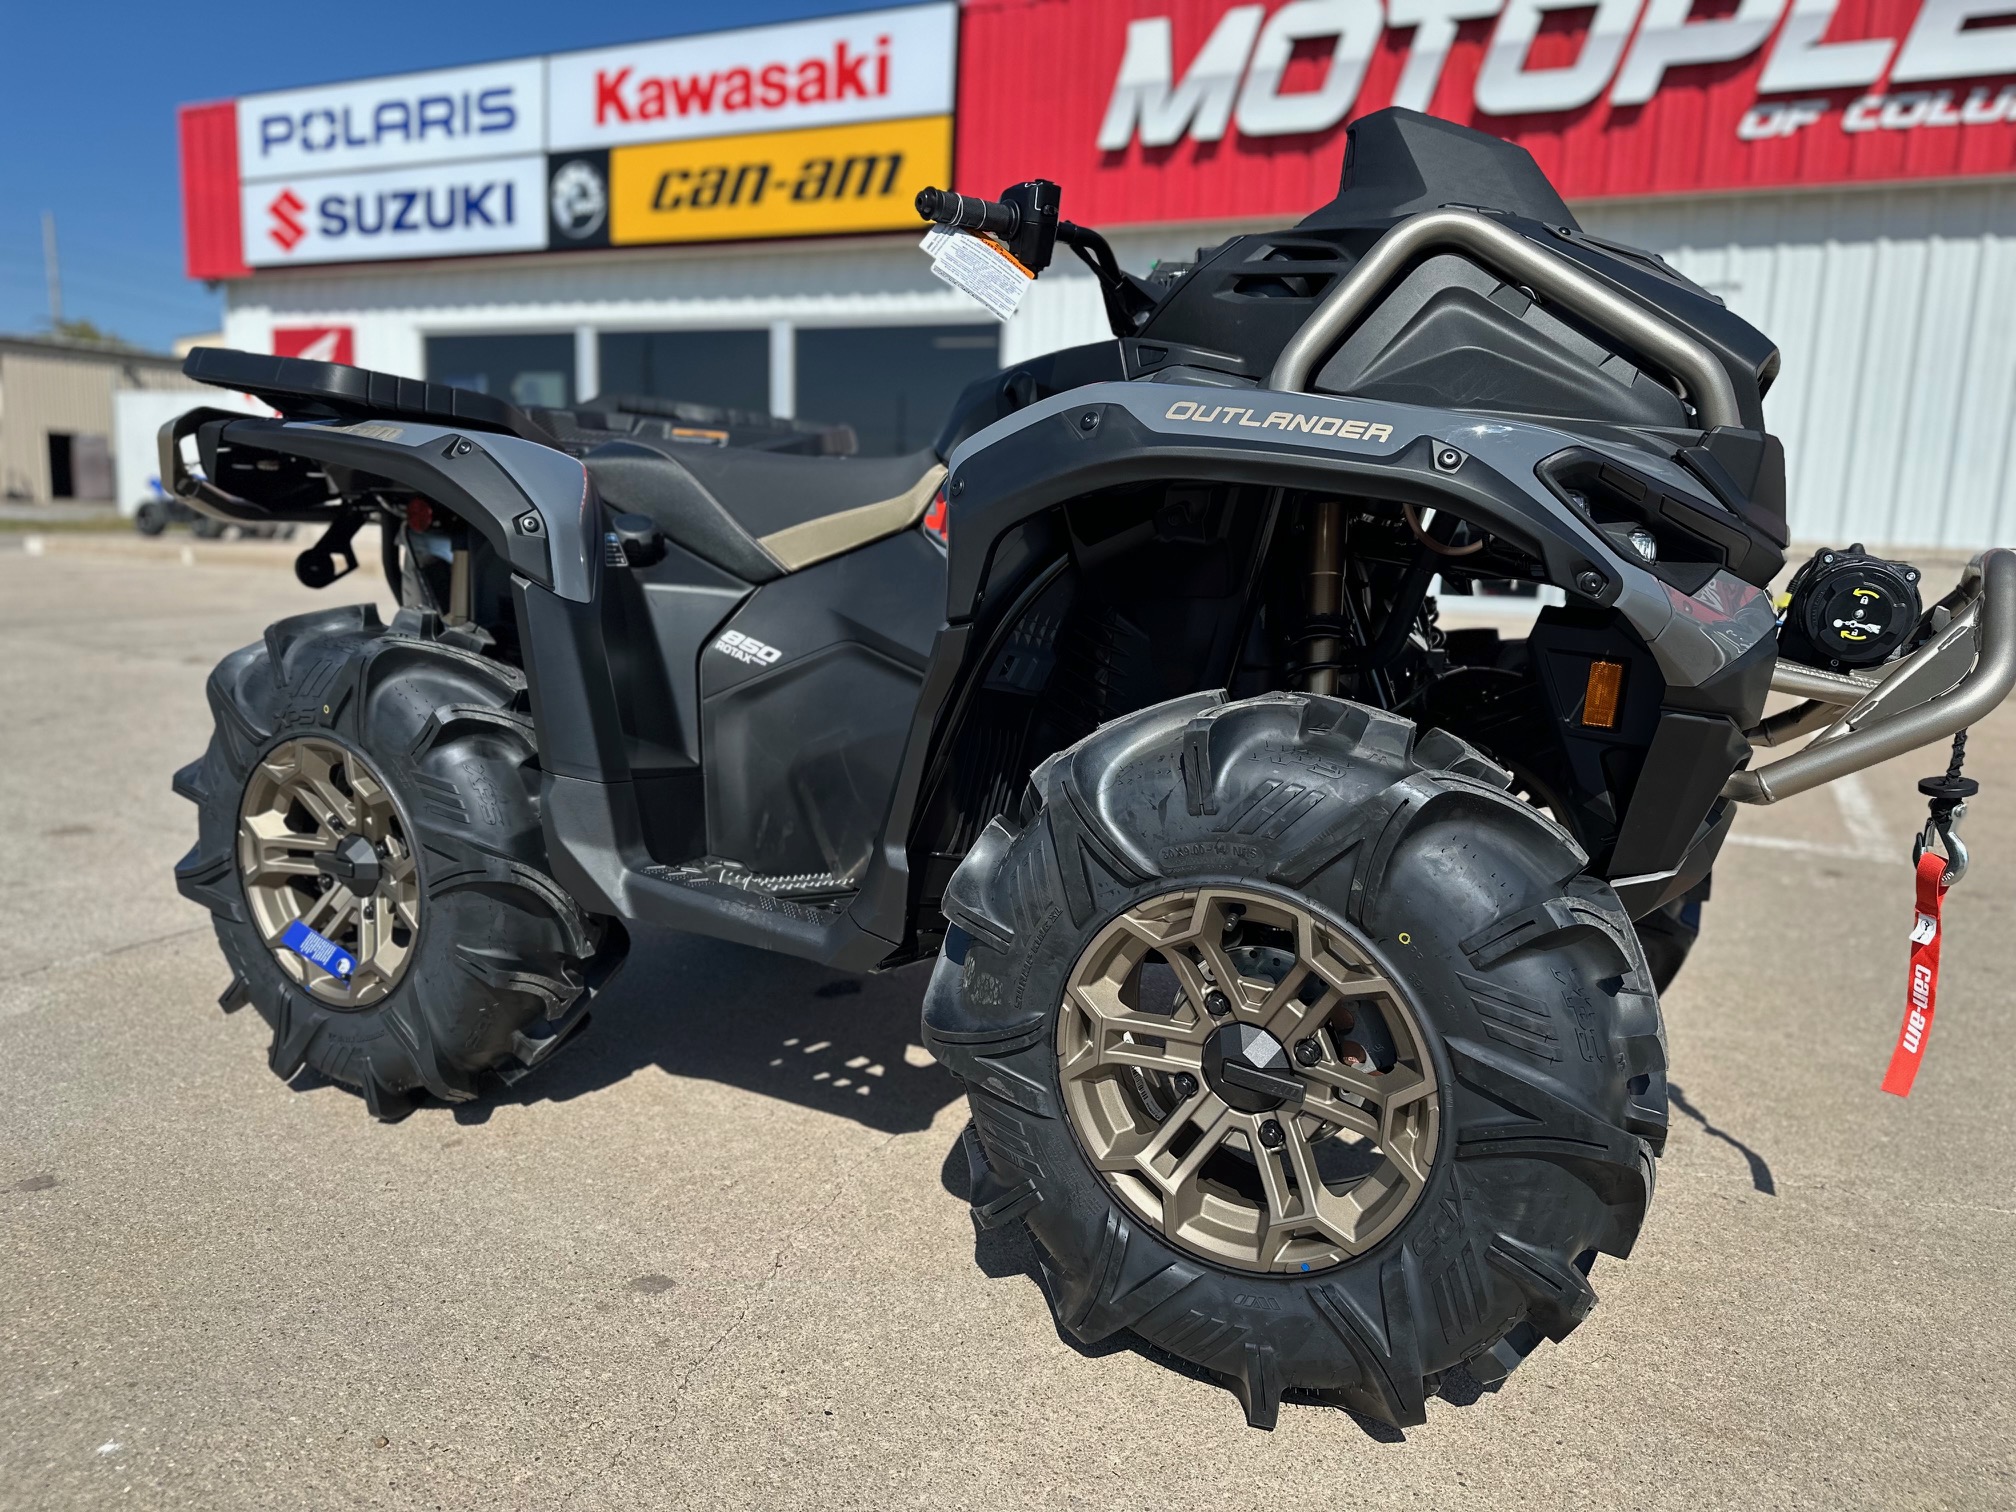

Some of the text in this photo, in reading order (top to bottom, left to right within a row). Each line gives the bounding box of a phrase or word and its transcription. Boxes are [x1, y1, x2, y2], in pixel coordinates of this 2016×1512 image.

[596, 35, 891, 127] Kawasaki
[261, 87, 517, 157] POLARIS
[1738, 85, 2016, 139] OF COLU
[318, 182, 516, 238] SUZUKI
[652, 152, 904, 212] can-am
[1165, 401, 1394, 443] OUTLANDER
[715, 640, 752, 664] ROTAX
[720, 629, 782, 663] 850
[1902, 963, 1932, 1054] can-am
